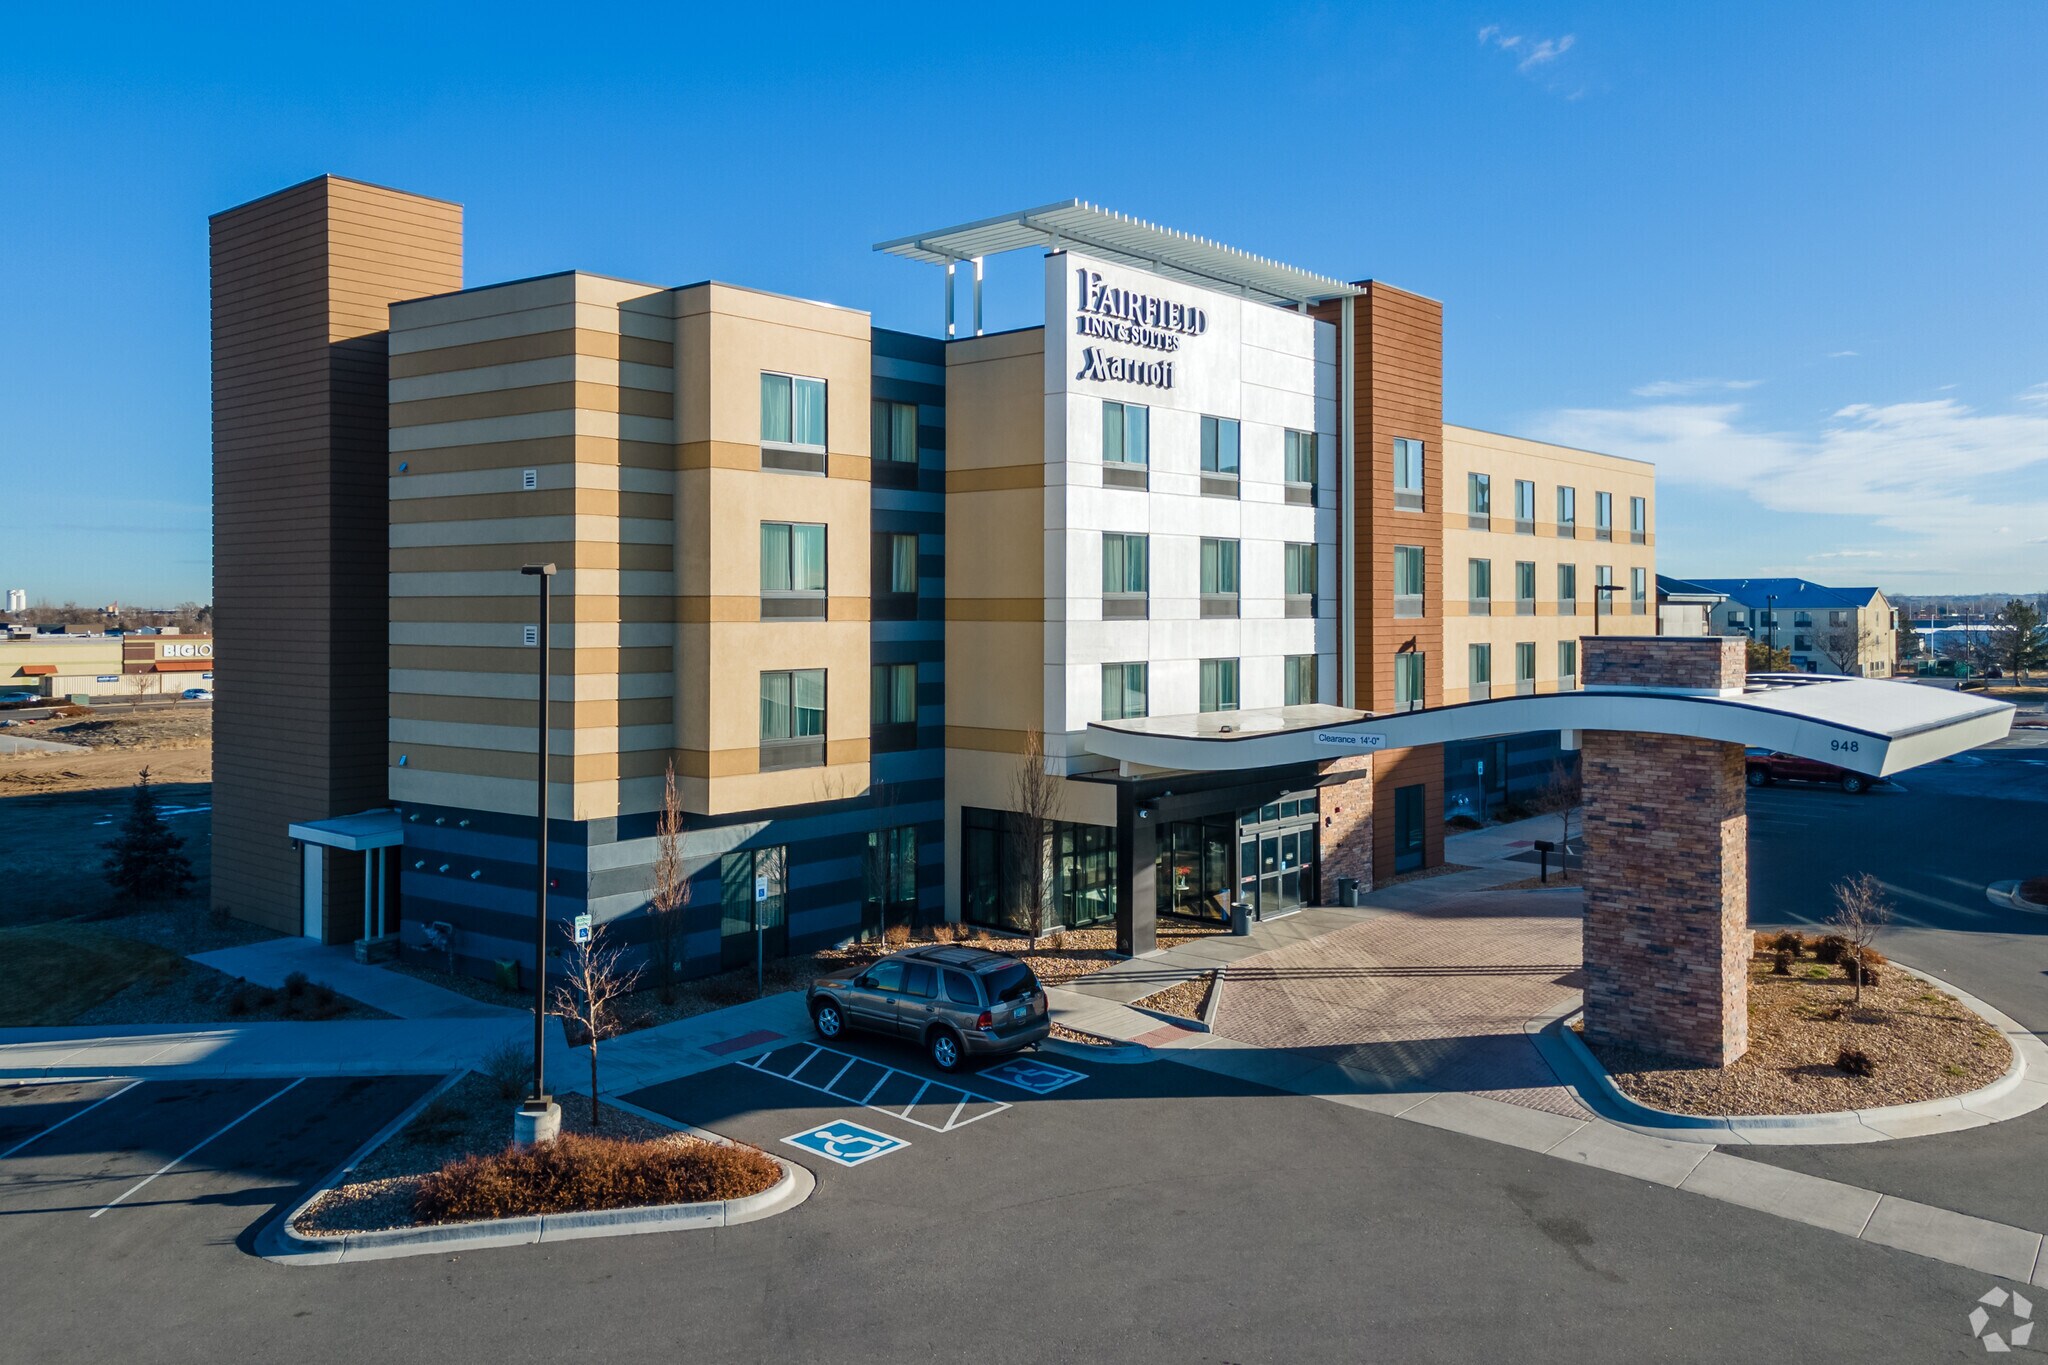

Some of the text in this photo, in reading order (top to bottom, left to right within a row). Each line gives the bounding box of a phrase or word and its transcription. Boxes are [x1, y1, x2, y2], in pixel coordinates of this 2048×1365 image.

[1076, 267, 1209, 336] FAIRFIELD
[1076, 314, 1117, 341] INN
[1129, 325, 1181, 353] SUITES
[1076, 345, 1177, 390] Marriott
[1318, 733, 1356, 744] Clearance
[1830, 739, 1859, 753] 948
